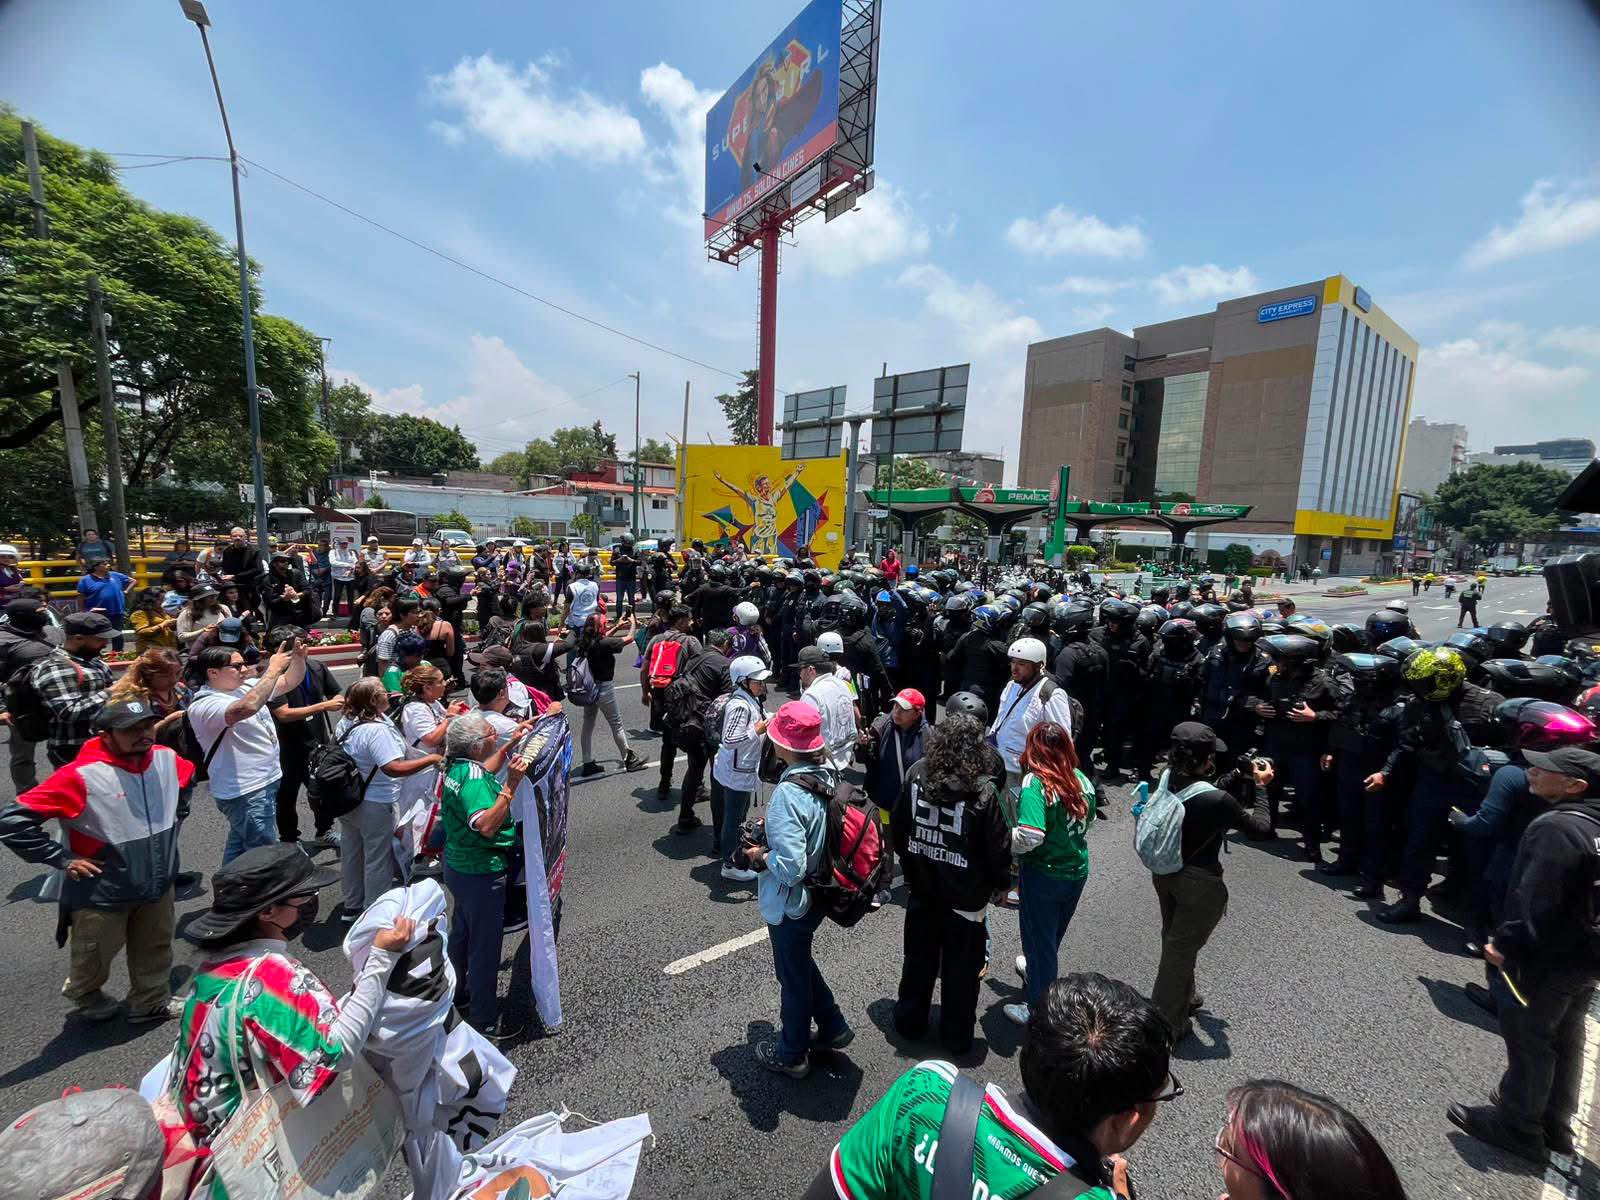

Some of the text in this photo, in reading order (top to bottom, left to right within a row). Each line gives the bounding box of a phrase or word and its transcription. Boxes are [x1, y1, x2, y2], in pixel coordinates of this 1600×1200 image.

[712, 43, 829, 160] SUPEGIRL
[783, 149, 805, 178] CINES
[1260, 306, 1277, 316] CITY
[1278, 299, 1313, 312] EXPRESS
[1008, 492, 1049, 502] PEMEX
[1202, 506, 1240, 514] PEMEX
